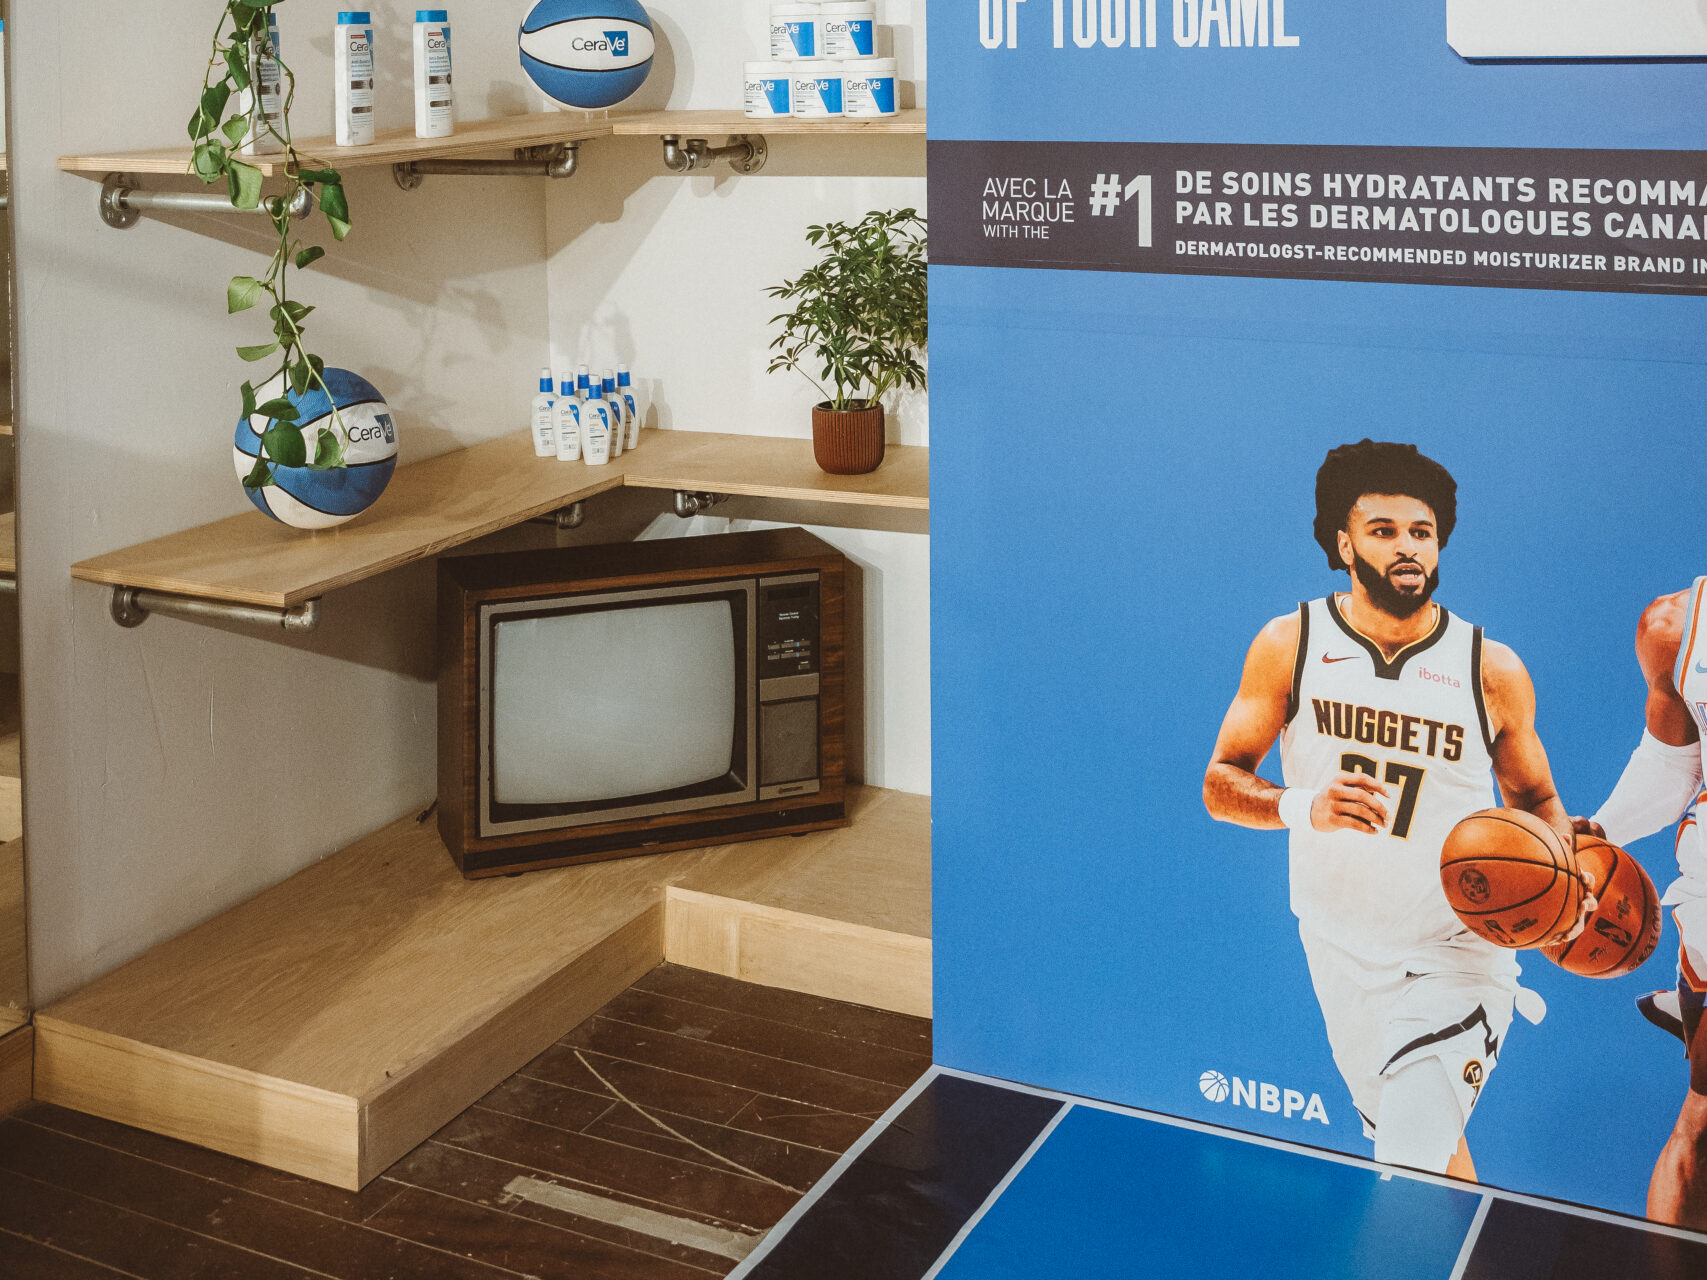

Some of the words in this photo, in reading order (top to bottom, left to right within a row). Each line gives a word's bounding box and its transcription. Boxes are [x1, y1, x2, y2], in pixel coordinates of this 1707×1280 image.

[826, 22, 860, 33] CeraVe
[571, 36, 625, 51] CeraVe
[795, 80, 828, 91] CeraVe
[847, 79, 880, 91] CeraVe
[982, 177, 1037, 199] AVEC
[1043, 178, 1073, 199] LA
[1177, 171, 1211, 194] DE
[1223, 172, 1311, 196] SOINS
[1324, 174, 1535, 202] HYDRATANTS
[982, 200, 1075, 223] MARQUE
[1090, 174, 1151, 247] #1
[1177, 201, 1232, 225] PAR
[1245, 203, 1298, 227] LES
[1311, 205, 1591, 236] DERMATOLOGUES
[1605, 213, 1707, 240] CANA
[983, 224, 1019, 239] WITH
[1022, 225, 1050, 240] THE
[1176, 241, 1466, 264] DERMATOLOGST-RECOMMENDED
[1474, 251, 1606, 270] MOISTURIZER
[1615, 256, 1684, 272] BRAND
[348, 418, 394, 443] CeraVe
[1418, 667, 1461, 688] ibotta
[1312, 698, 1464, 762] NUGGETS
[1233, 1077, 1329, 1124] NBPA
